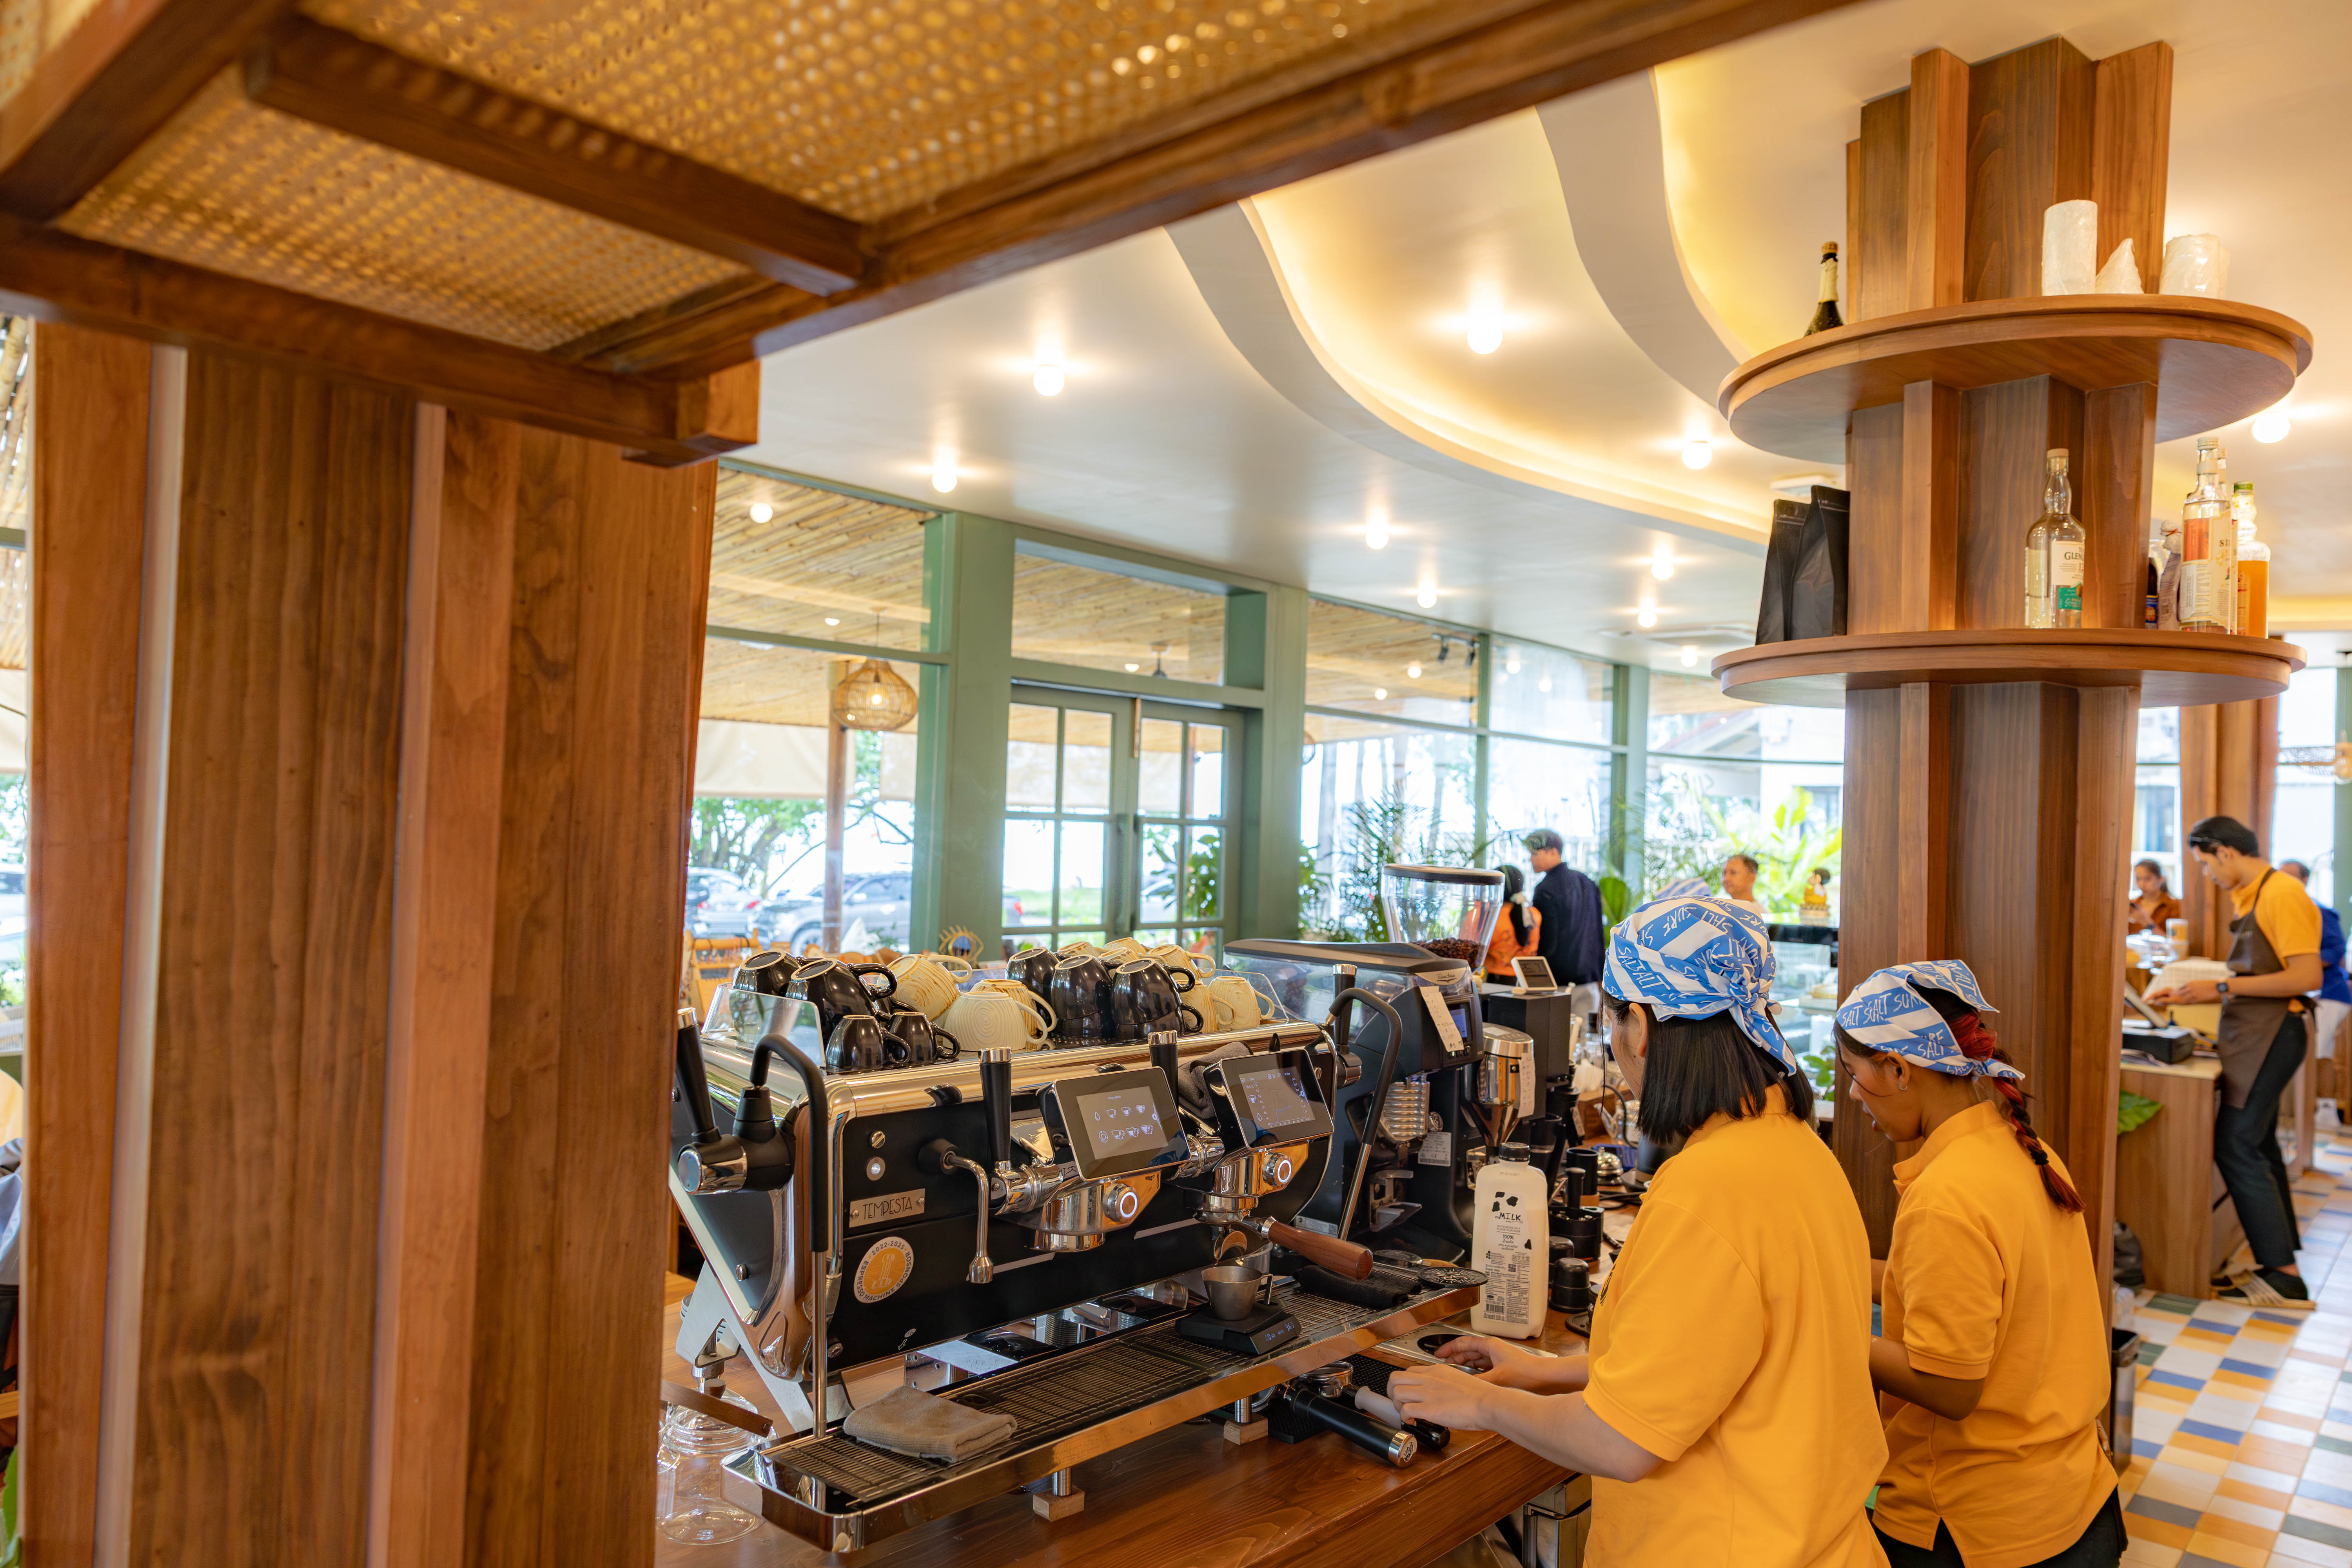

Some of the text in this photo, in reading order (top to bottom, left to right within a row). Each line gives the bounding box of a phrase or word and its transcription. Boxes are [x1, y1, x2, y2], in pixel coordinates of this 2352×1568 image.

[1841, 1005, 1863, 1027] SALT
[863, 1196, 913, 1220] TEMPESTA
[871, 1241, 905, 1256] 2022-2025
[857, 1251, 911, 1301] ESPRESSO MACHINE SPONSOR
